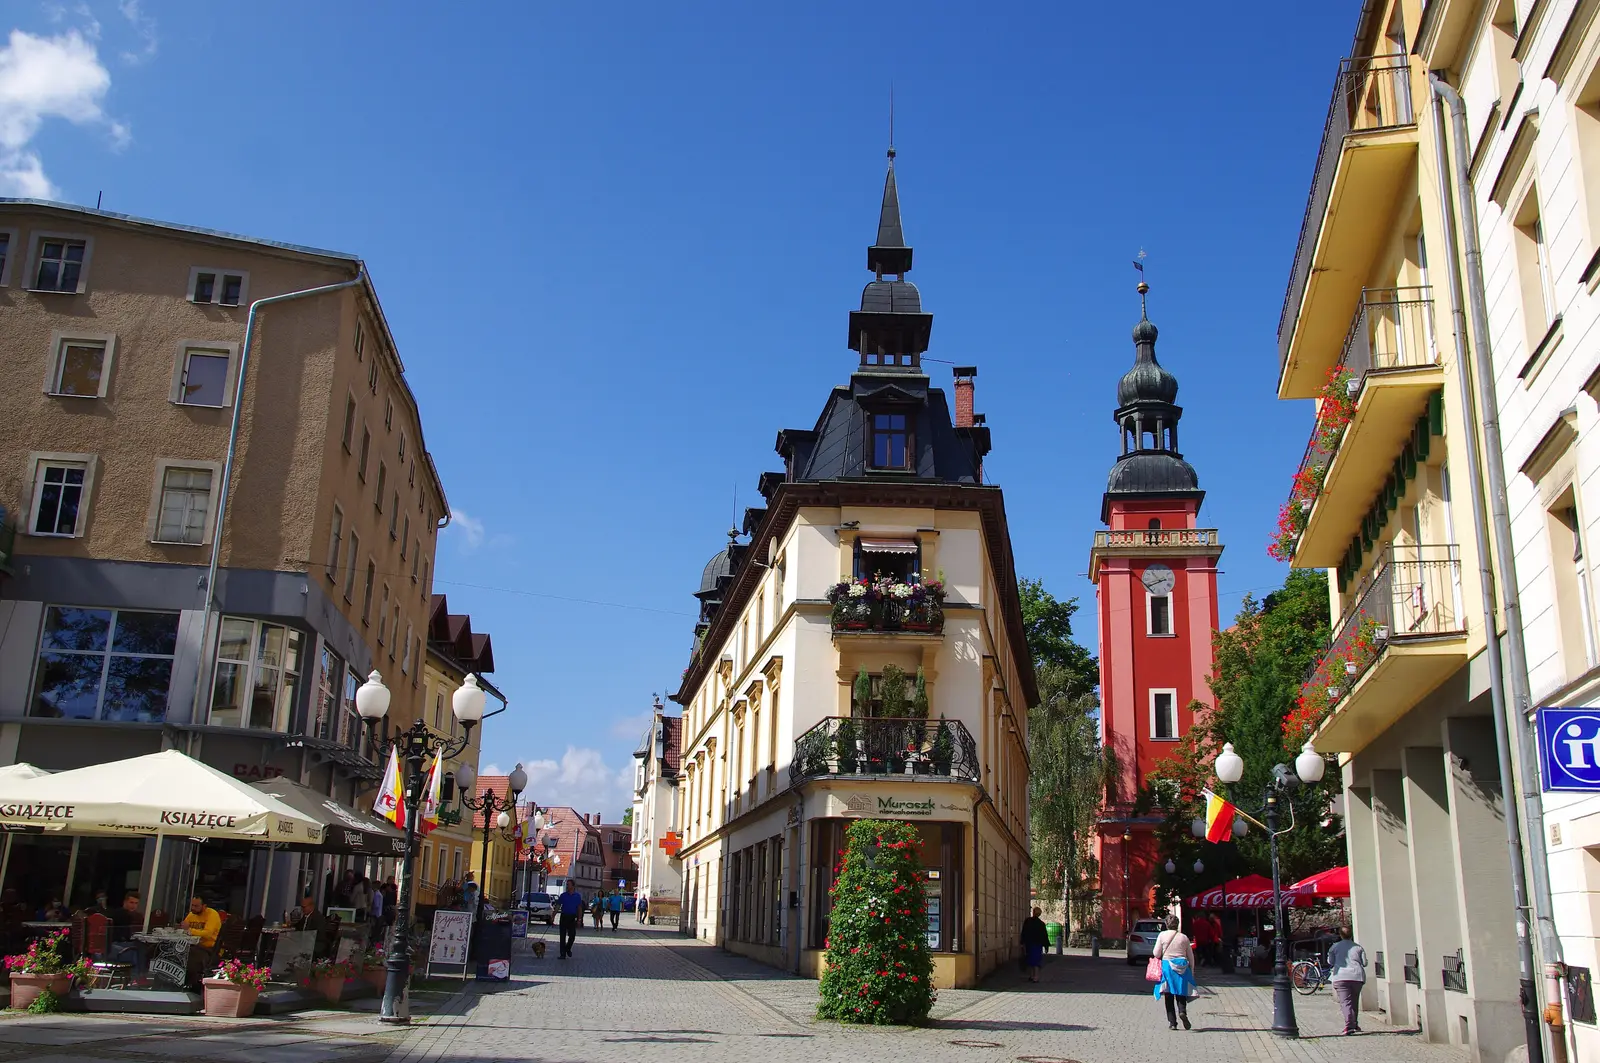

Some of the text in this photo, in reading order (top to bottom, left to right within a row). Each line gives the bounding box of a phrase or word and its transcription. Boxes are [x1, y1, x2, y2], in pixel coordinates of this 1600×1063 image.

[877, 796, 935, 810] Muraszk
[160, 810, 237, 829] KSIĄŻĘCE
[343, 830, 364, 846] Kozel
